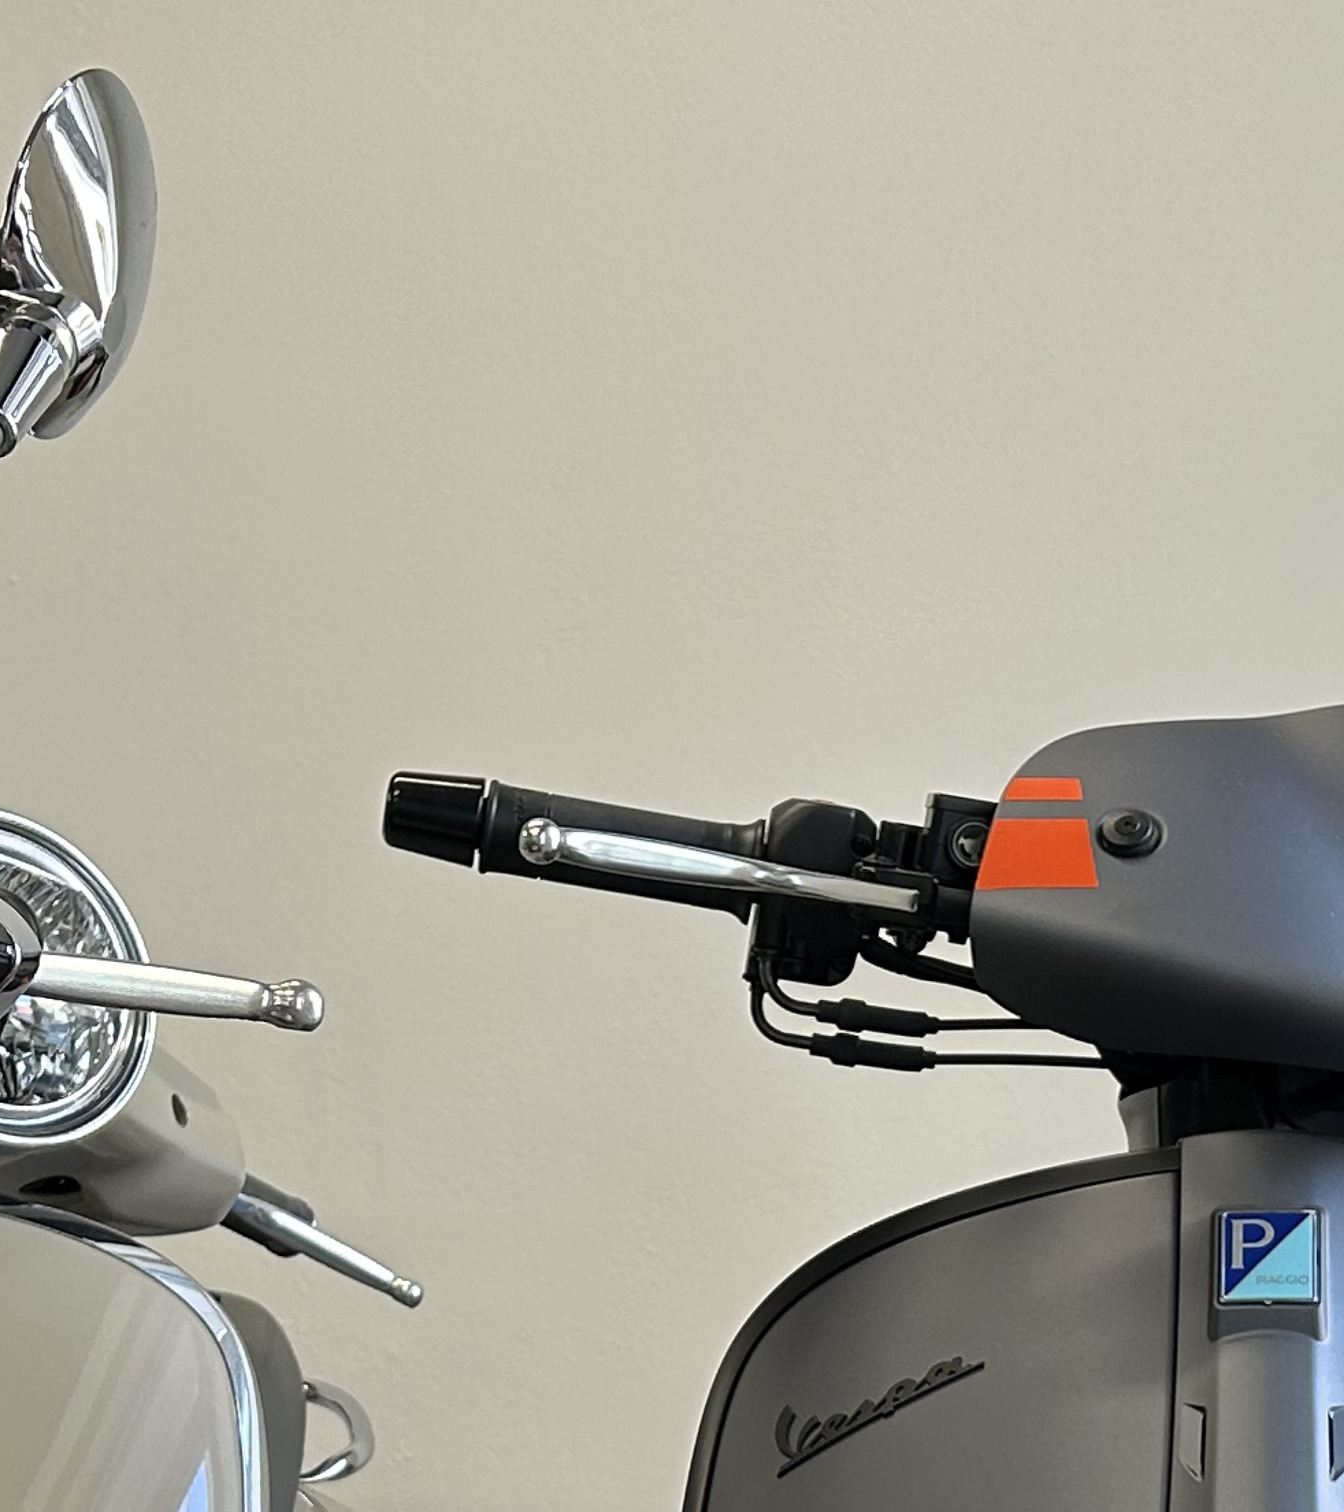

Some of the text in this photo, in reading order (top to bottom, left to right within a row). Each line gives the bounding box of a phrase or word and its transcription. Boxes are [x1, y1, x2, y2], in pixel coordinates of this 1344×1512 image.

[1230, 1218, 1275, 1269] P
[1256, 1273, 1310, 1285] PIAGGIO
[775, 1356, 985, 1479] Vespa
